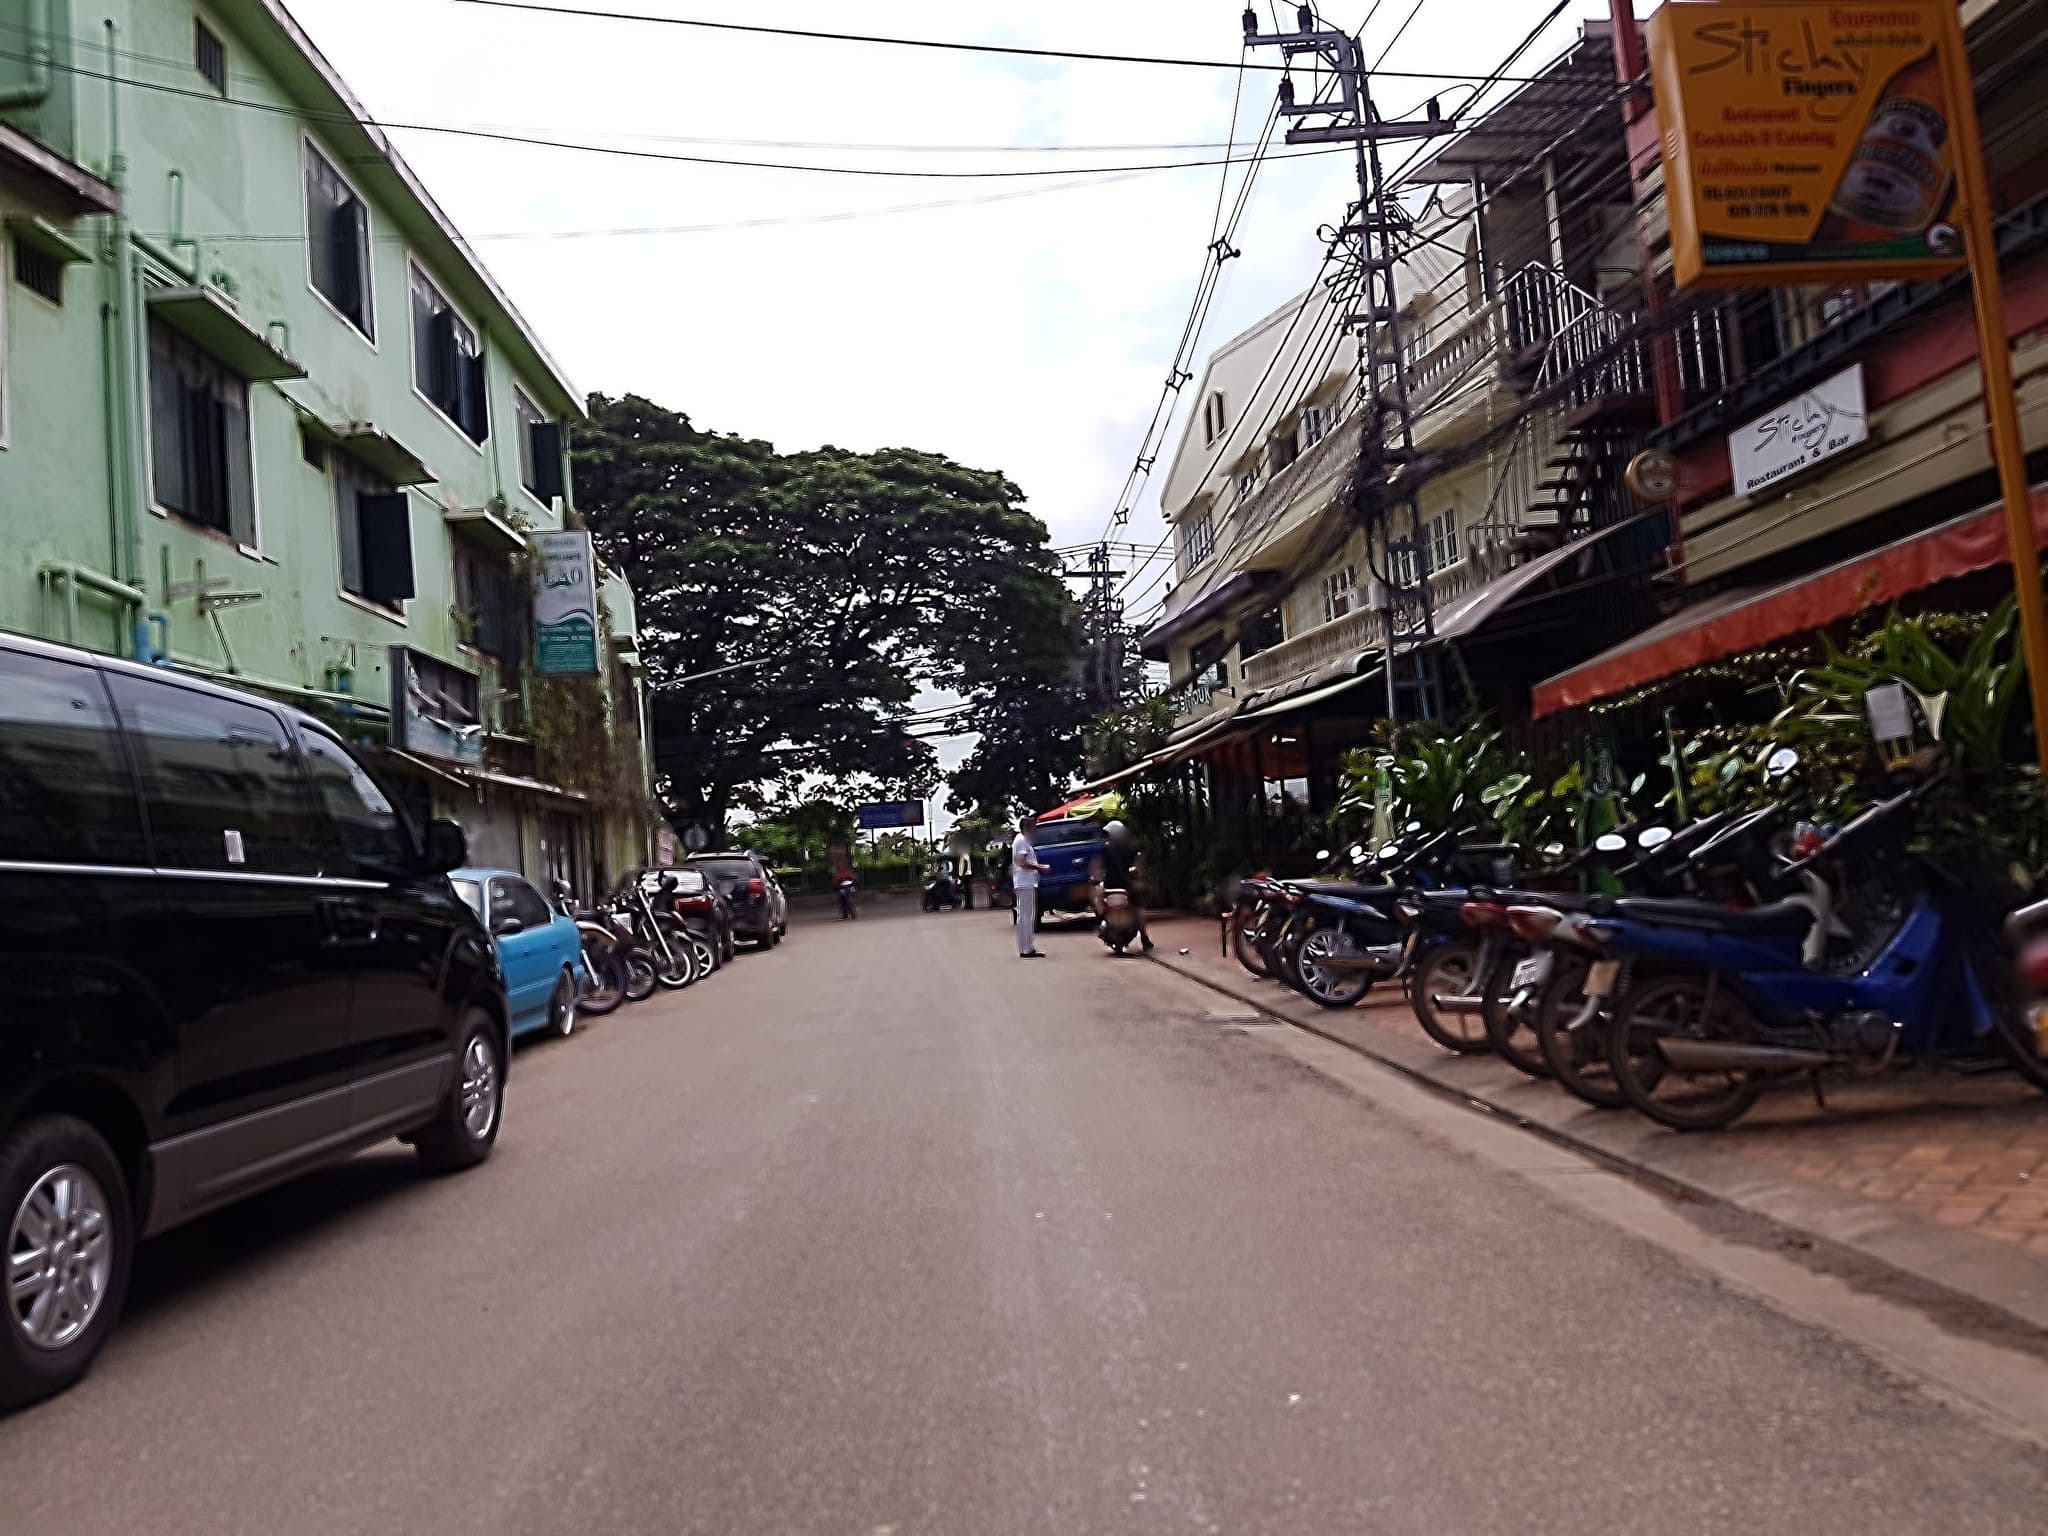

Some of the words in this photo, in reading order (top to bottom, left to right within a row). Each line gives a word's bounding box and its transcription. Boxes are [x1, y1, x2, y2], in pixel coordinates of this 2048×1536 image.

[1688, 16, 1870, 124] Sticky
[1783, 78, 1858, 98] Fingers
[1754, 392, 1864, 452] Sticky
[1747, 454, 1806, 490] Restaurant
[1812, 447, 1821, 459] &
[1828, 434, 1850, 451] Bar
